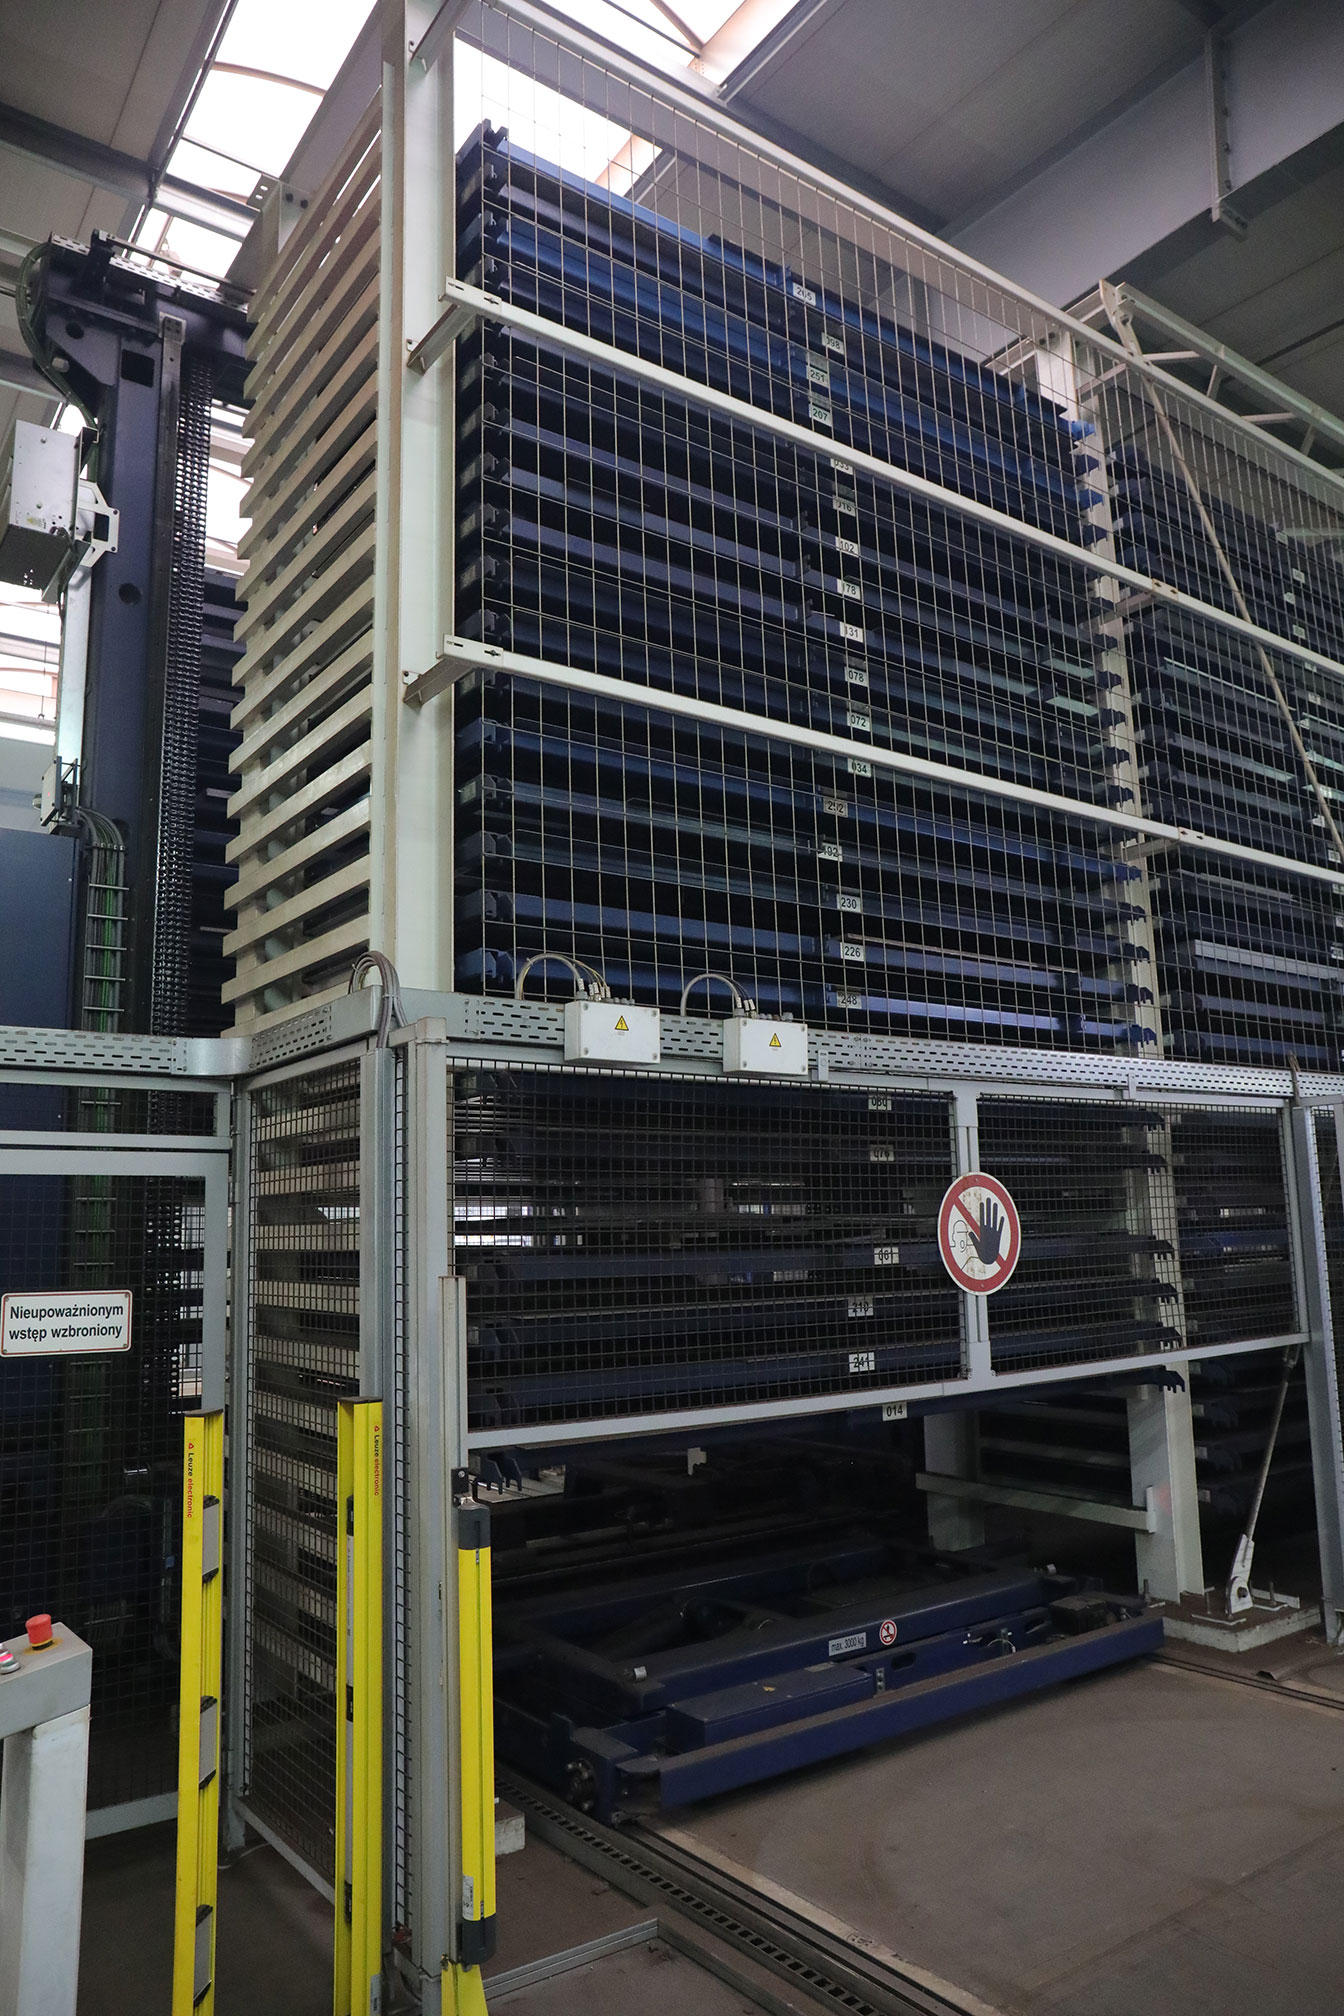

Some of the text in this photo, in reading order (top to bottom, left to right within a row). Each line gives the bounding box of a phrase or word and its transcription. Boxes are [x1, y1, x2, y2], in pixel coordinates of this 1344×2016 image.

[810, 369, 825, 383] 251
[812, 408, 828, 421] 207
[842, 583, 857, 595] 78
[848, 670, 864, 683] 078
[850, 714, 866, 728] 072
[841, 897, 857, 910] 230
[844, 945, 861, 958] 226
[841, 994, 858, 1006] 248
[10, 1304, 124, 1322] Nieupoważnionym
[9, 1323, 122, 1342] wstęp wzbroniony
[886, 1404, 903, 1417] 014
[186, 1478, 194, 1518] electronic
